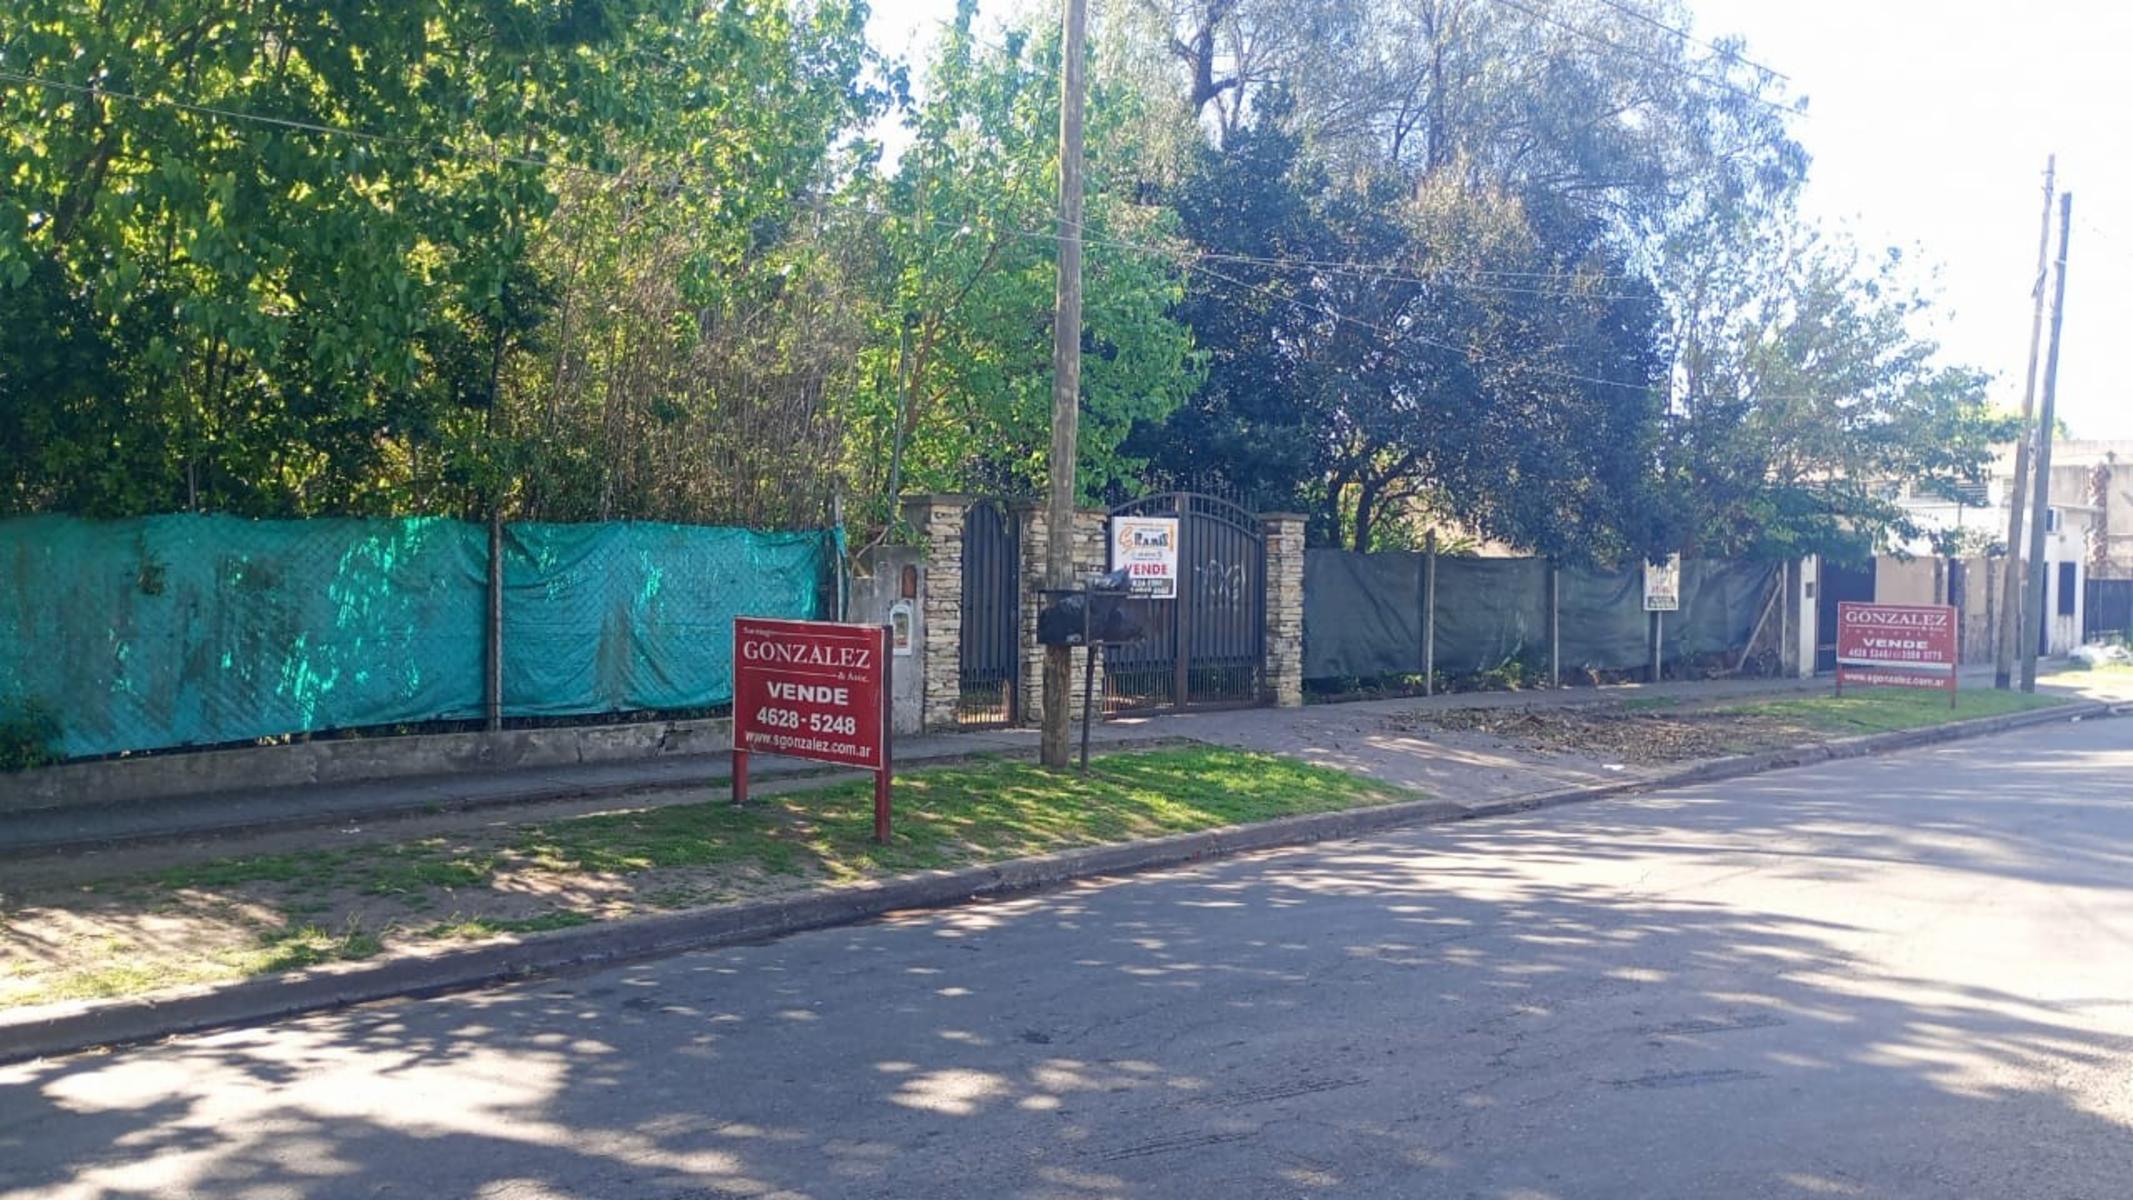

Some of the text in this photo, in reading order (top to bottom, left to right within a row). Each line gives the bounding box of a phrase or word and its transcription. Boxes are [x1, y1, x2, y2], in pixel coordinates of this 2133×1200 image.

[1124, 563, 1168, 576] VENDE
[1846, 611, 1947, 626] GONZALEZ
[1862, 637, 1928, 649] VENDE
[744, 640, 871, 669] GONZALEZ
[766, 681, 849, 706] VENDE
[745, 730, 872, 758] www.sgonzalez.com.ar
